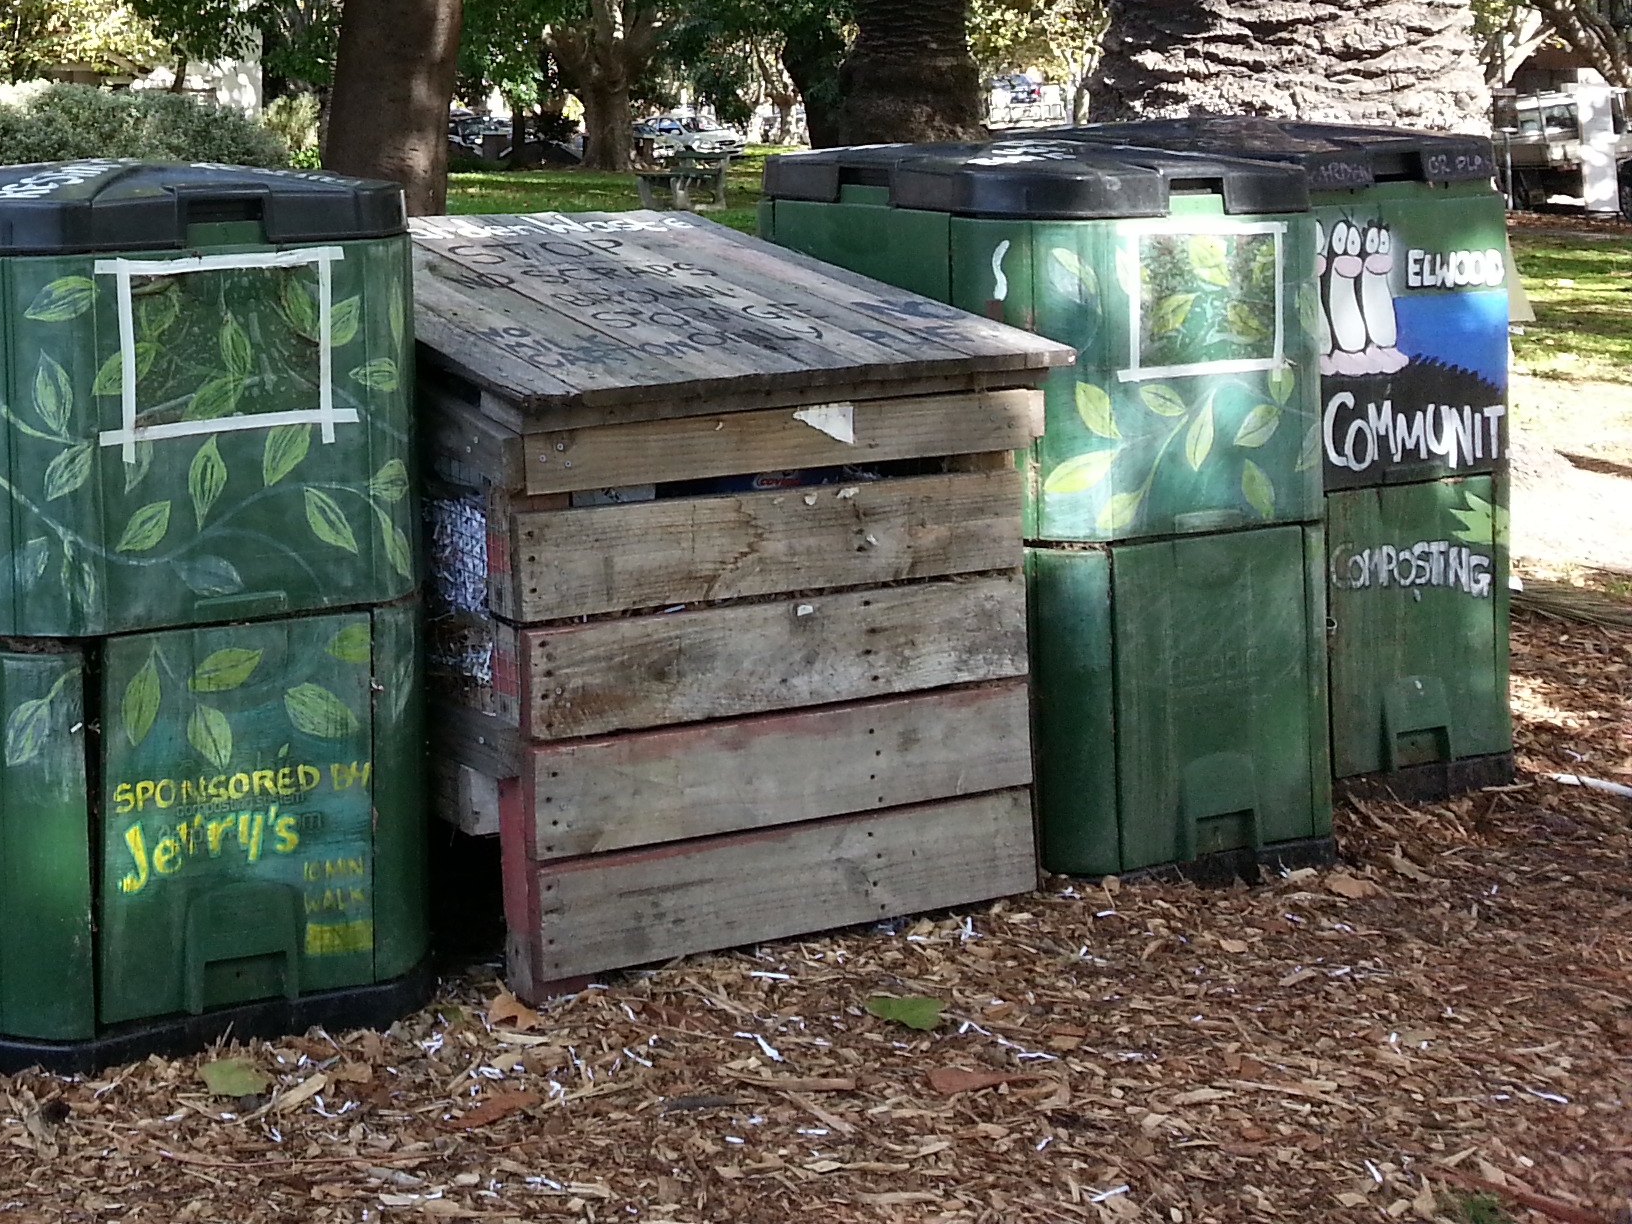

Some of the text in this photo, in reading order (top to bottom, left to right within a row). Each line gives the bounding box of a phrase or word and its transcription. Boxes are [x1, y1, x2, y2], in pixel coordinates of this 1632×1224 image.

[408, 219, 547, 240] arden
[448, 238, 624, 265] STOP
[523, 261, 718, 285] SCRAPS
[1405, 249, 1506, 289] ELWOOD
[1323, 391, 1510, 470] COMMUNIT
[1331, 540, 1493, 597] COMPOSTING
[113, 764, 320, 814] SPONSORED
[120, 805, 300, 894] Jerry's
[324, 856, 364, 879] MIN
[303, 886, 365, 914] WALK
